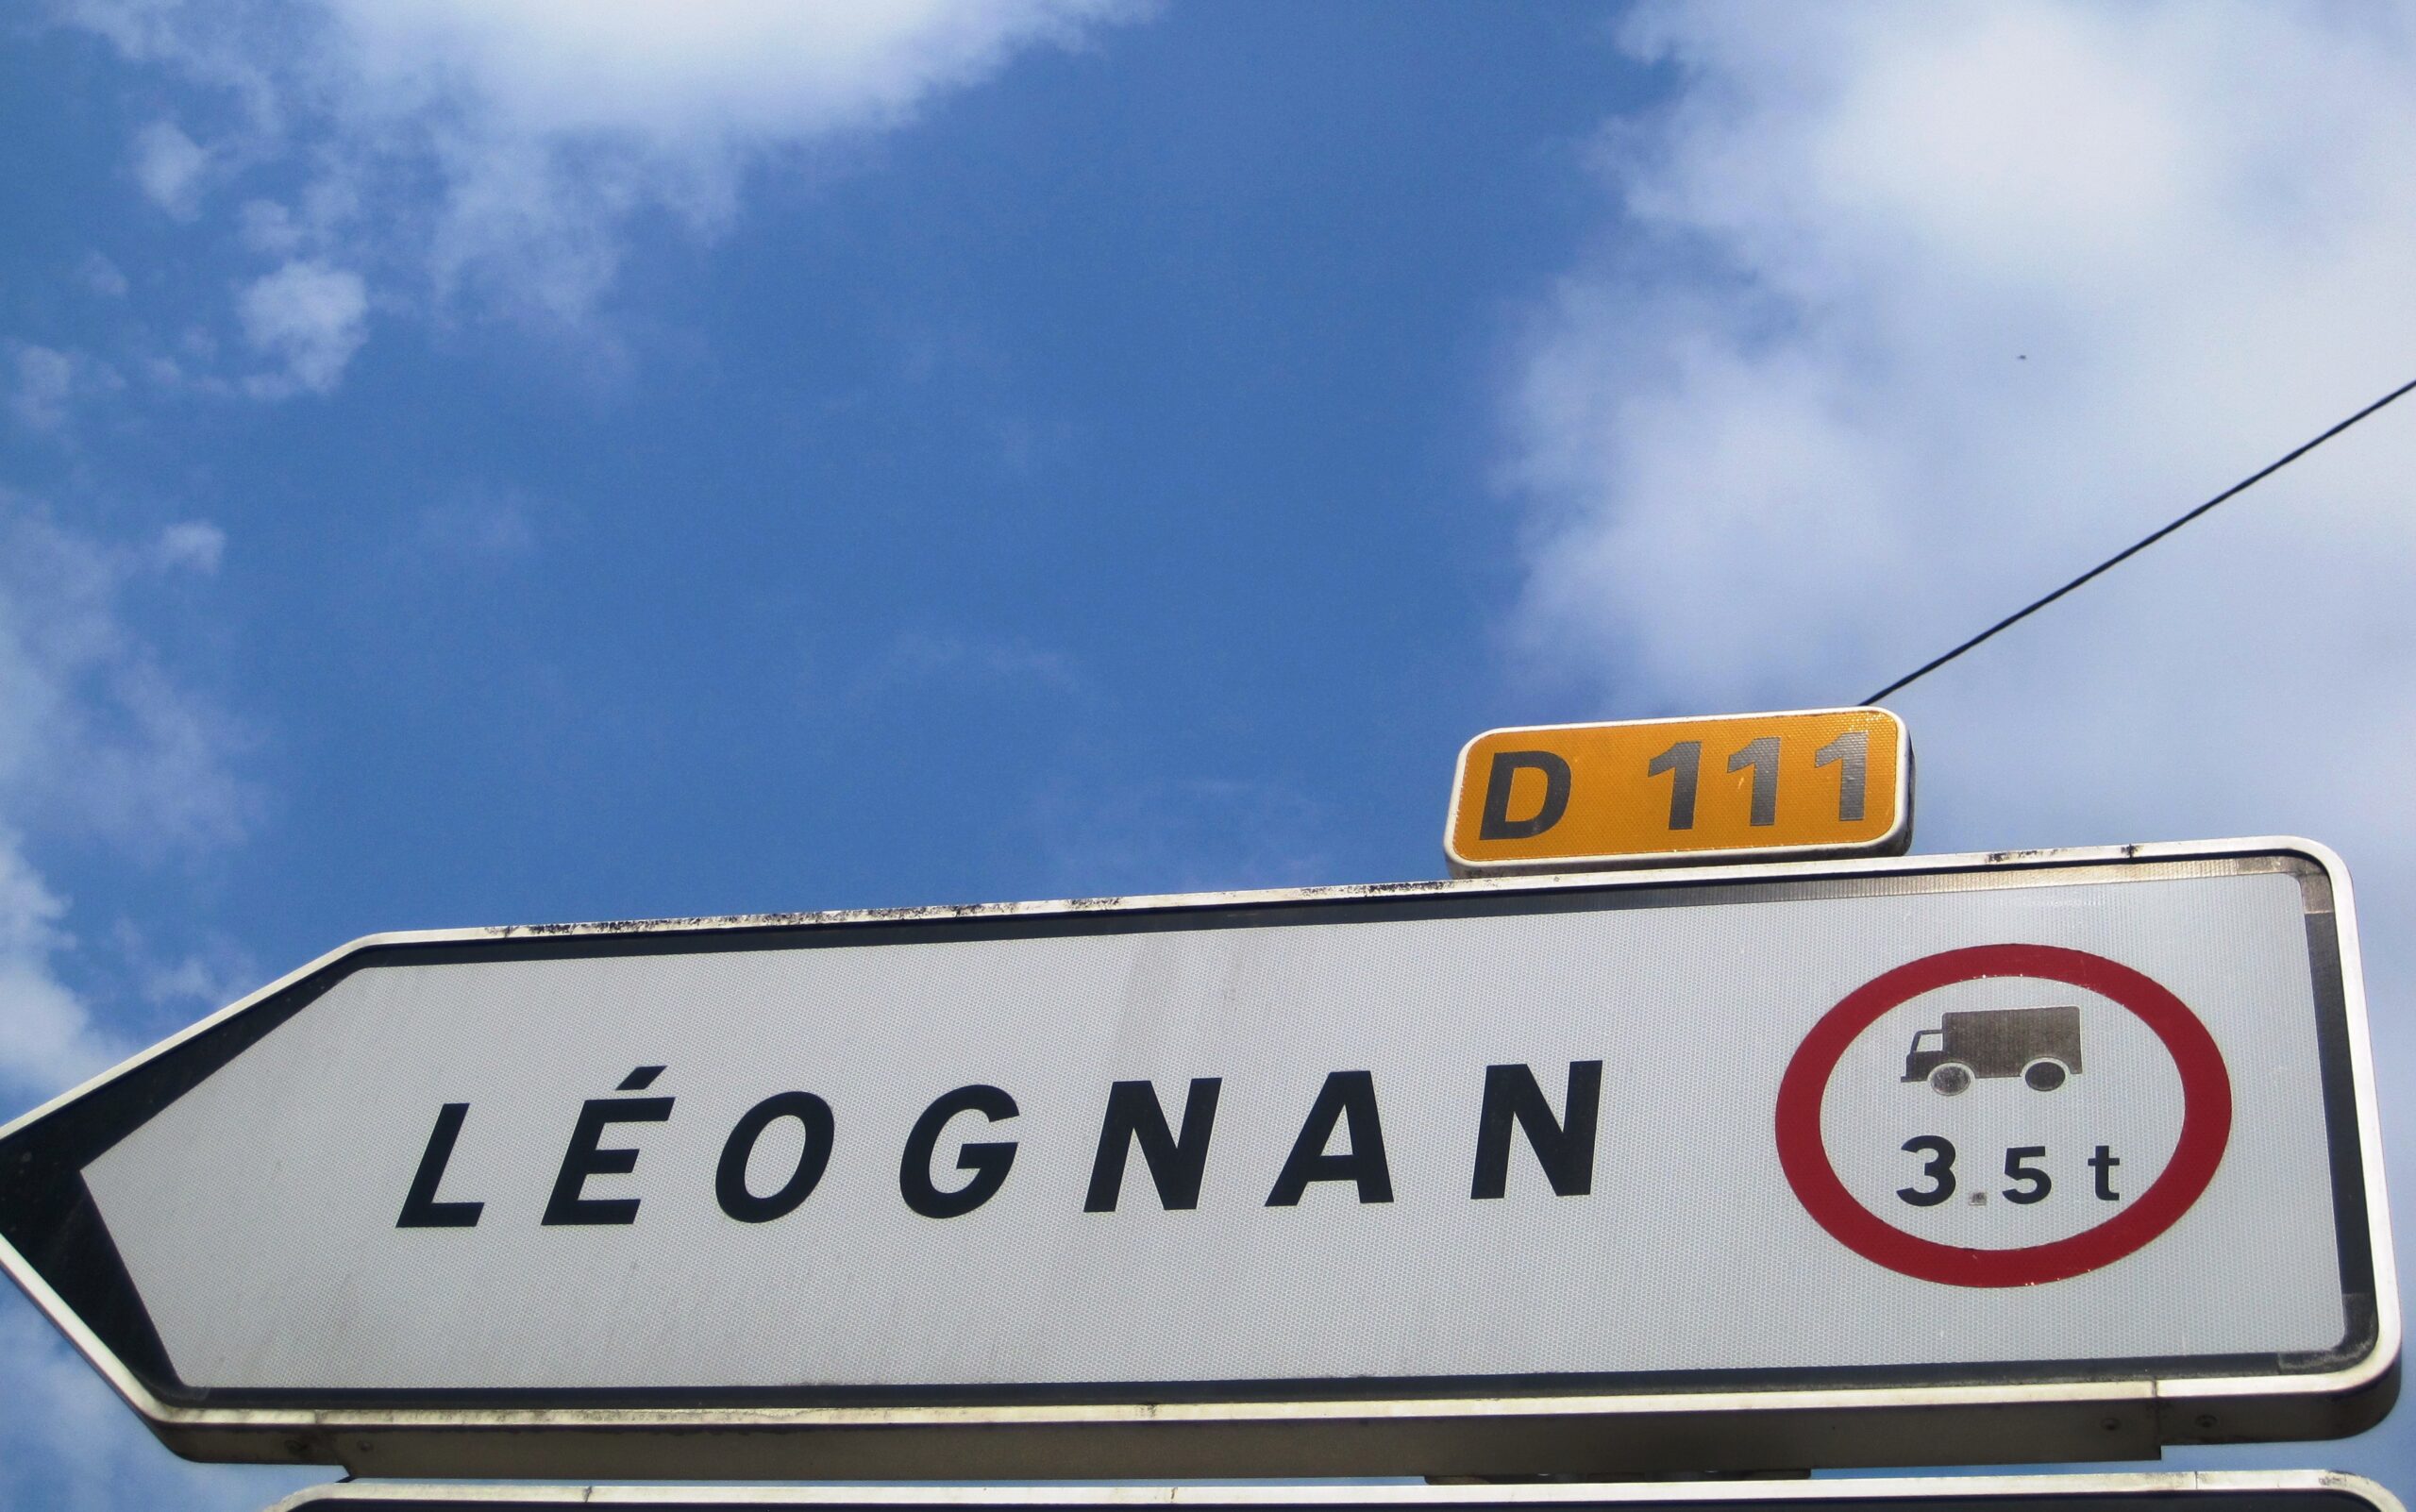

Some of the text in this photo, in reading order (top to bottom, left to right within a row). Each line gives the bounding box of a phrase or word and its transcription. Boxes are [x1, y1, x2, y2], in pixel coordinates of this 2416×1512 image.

[1479, 731, 1870, 840] D 111
[394, 1059, 1604, 1230] LÉOGNAN
